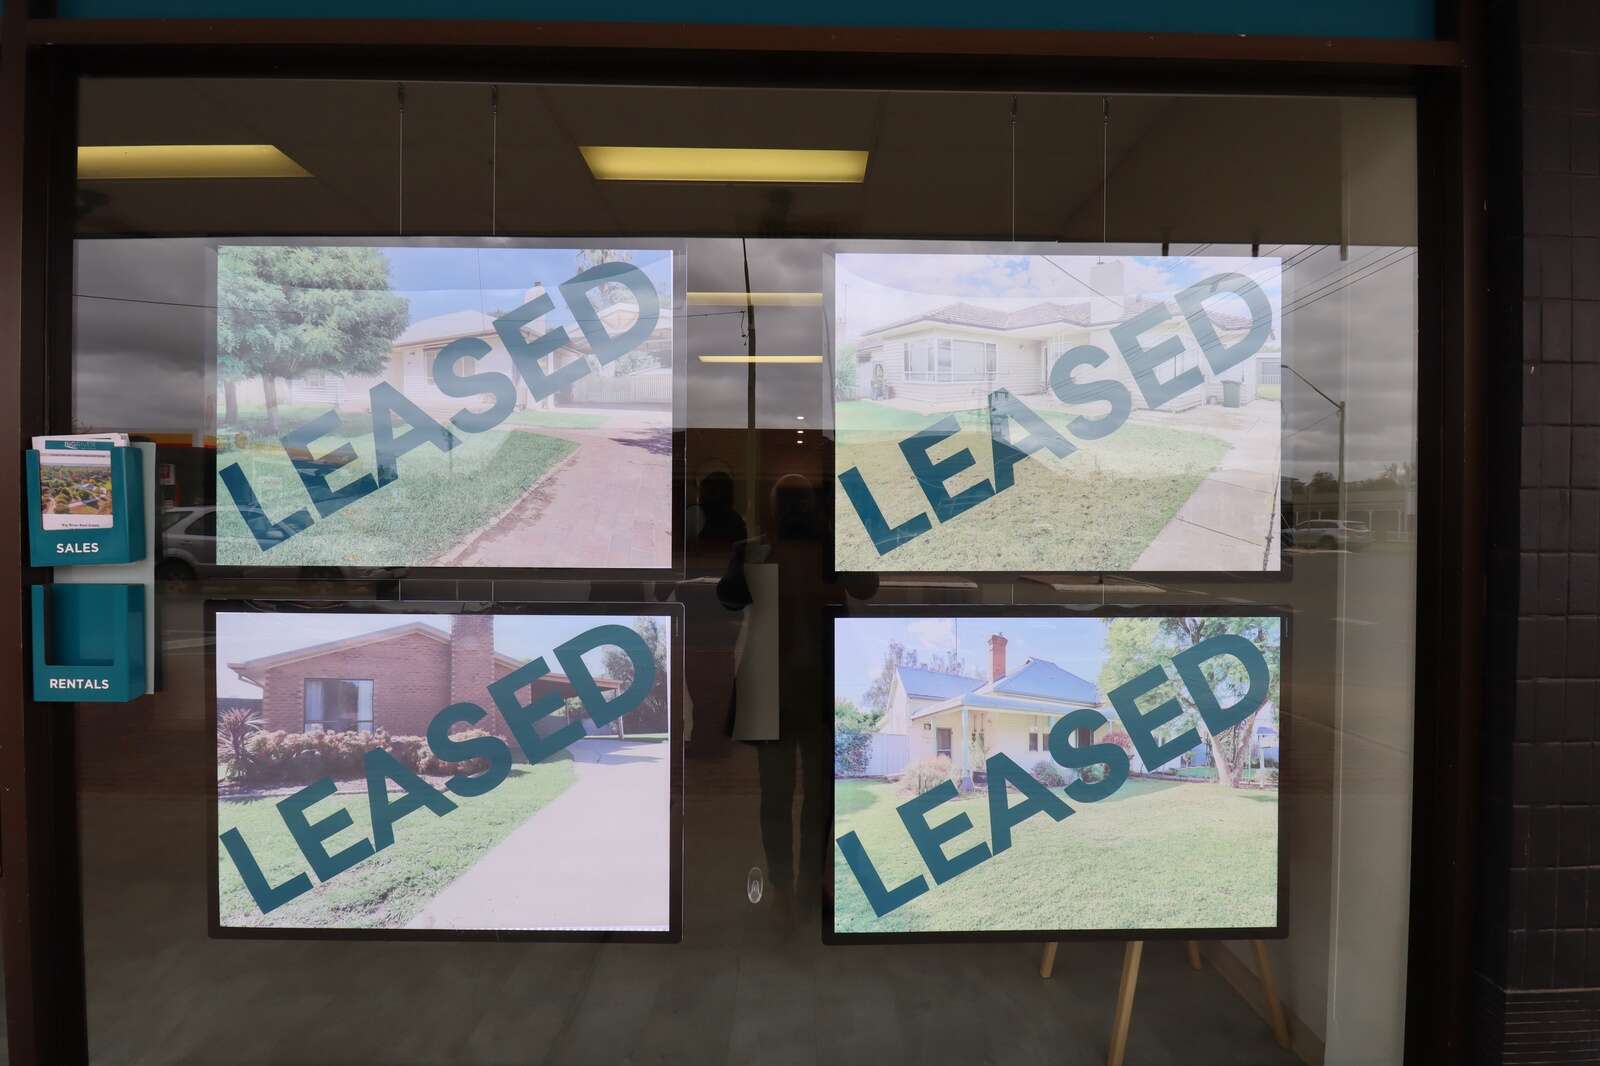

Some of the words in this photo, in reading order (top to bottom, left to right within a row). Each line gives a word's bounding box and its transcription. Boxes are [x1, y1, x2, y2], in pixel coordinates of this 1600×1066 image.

[56, 542, 99, 553] SALES
[219, 261, 660, 553] LEASED
[837, 272, 1273, 556] LEASED
[49, 678, 109, 689] RENTALS
[219, 624, 657, 915] LEASED
[836, 633, 1270, 918] LEASED
